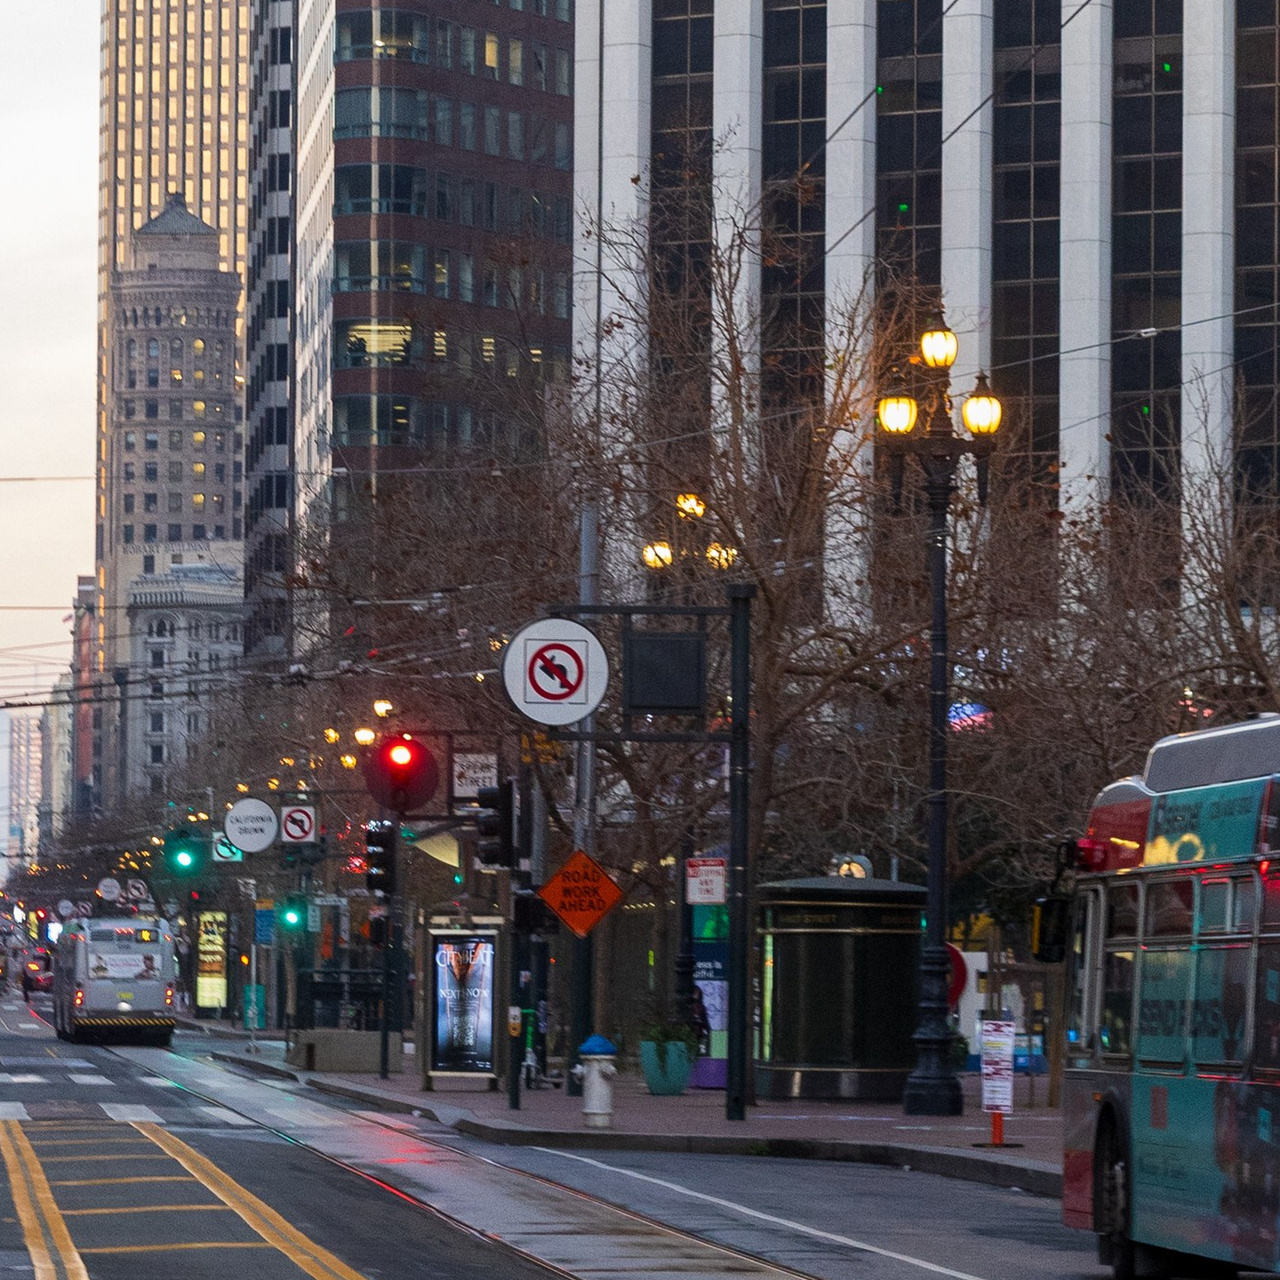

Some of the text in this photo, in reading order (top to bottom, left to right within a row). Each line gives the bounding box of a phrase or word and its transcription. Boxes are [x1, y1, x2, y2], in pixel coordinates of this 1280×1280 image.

[164, 541, 212, 553] BUILDING
[561, 869, 601, 883] ROAD
[562, 885, 600, 898] WORK
[559, 899, 606, 912] AHEAD
[435, 949, 494, 968] CITYBEAT
